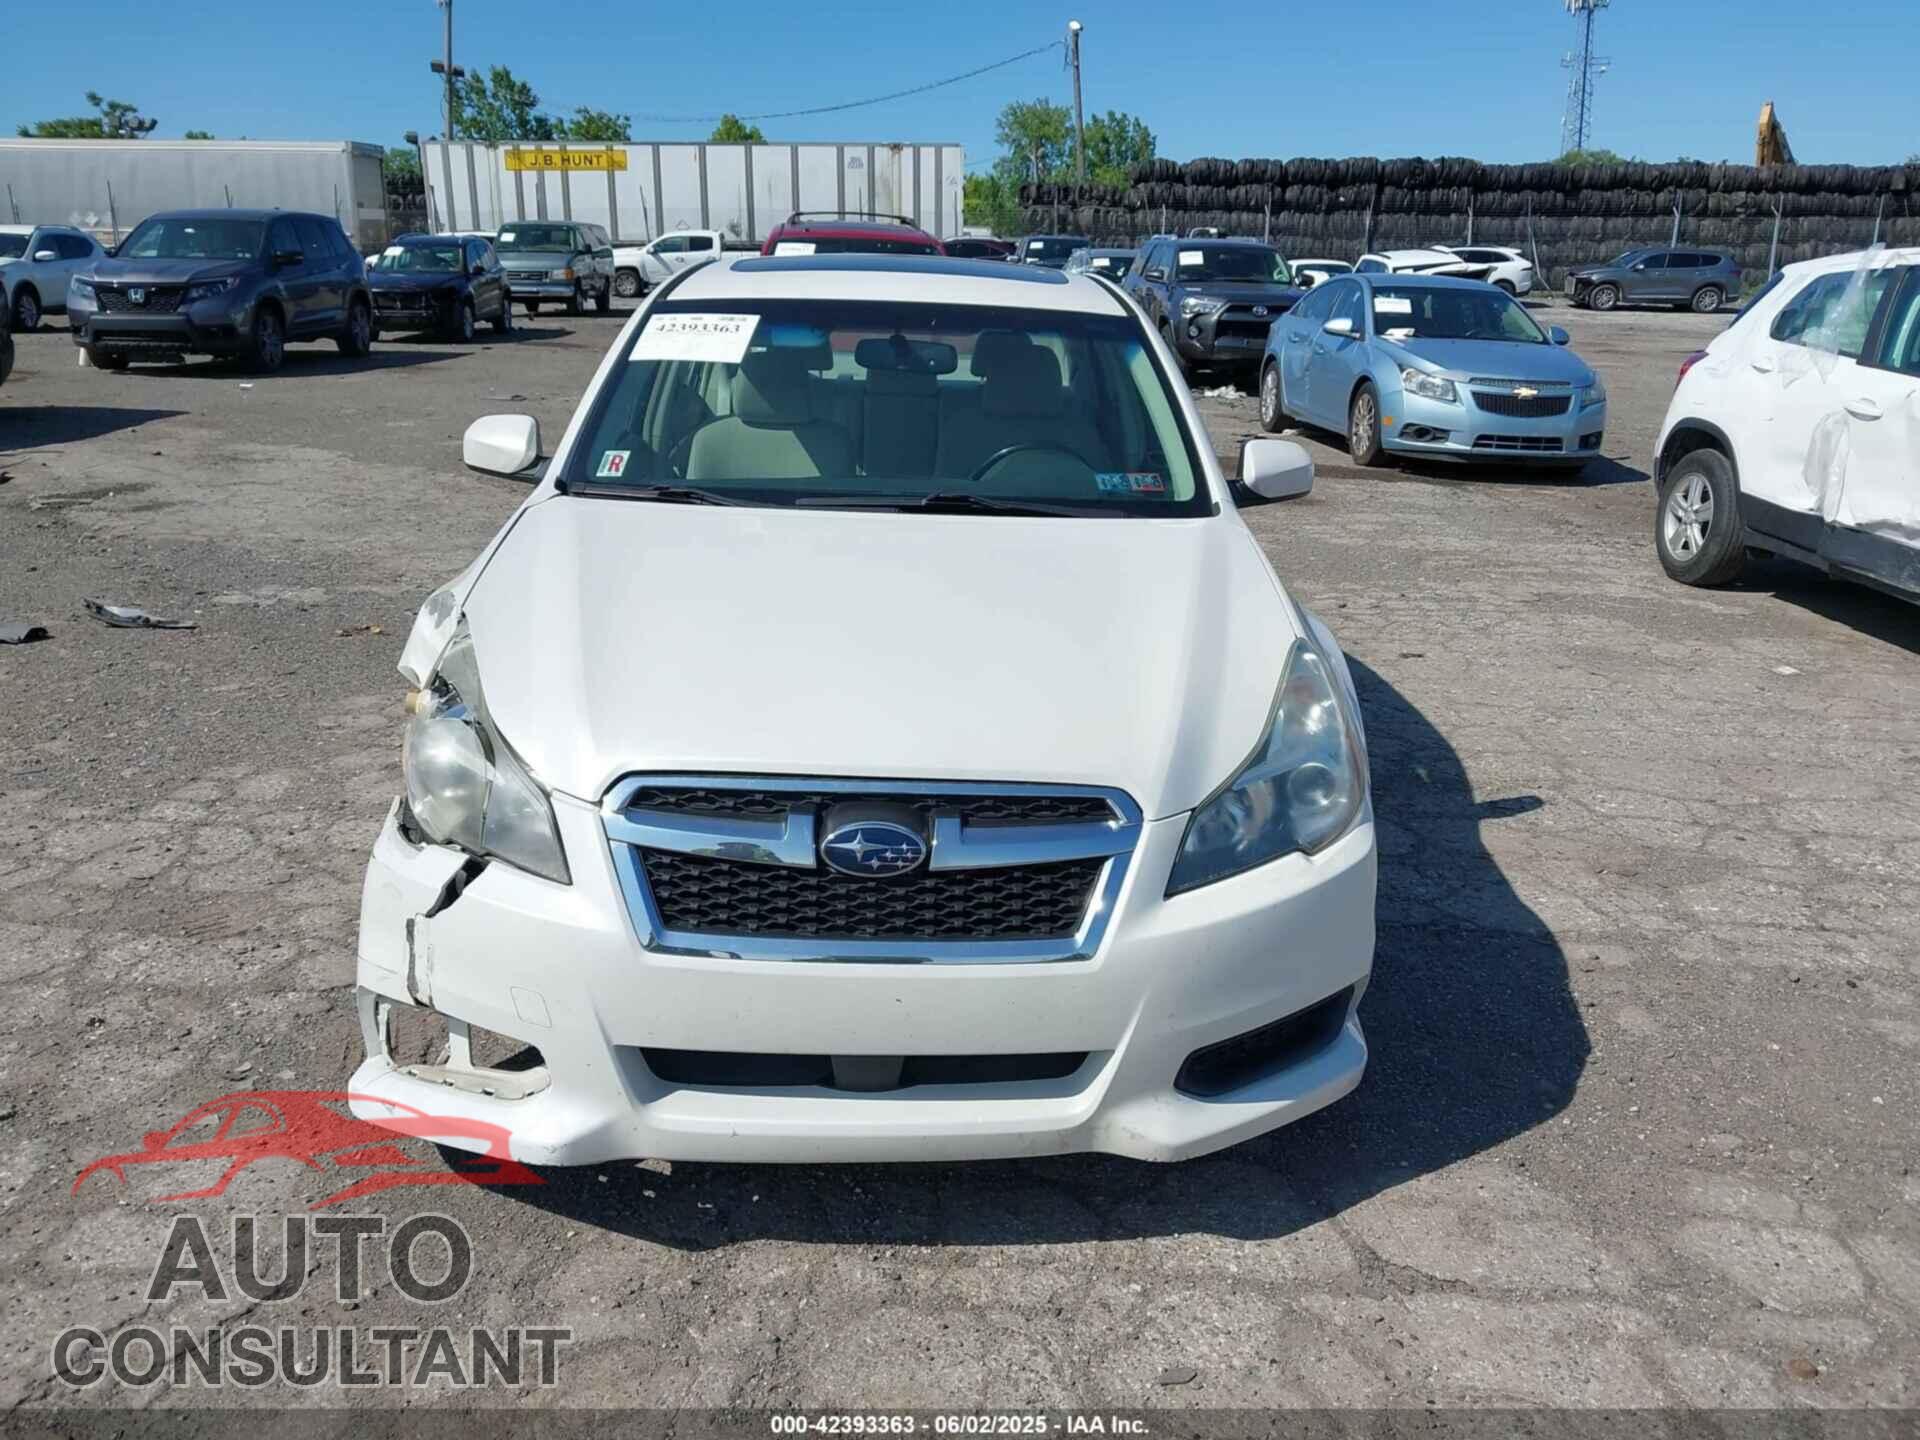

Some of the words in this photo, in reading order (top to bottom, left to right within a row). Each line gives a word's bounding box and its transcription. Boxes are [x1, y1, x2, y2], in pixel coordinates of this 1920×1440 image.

[561, 154, 603, 166] HUNT
[655, 322, 742, 333] 42393363
[608, 454, 624, 472] R
